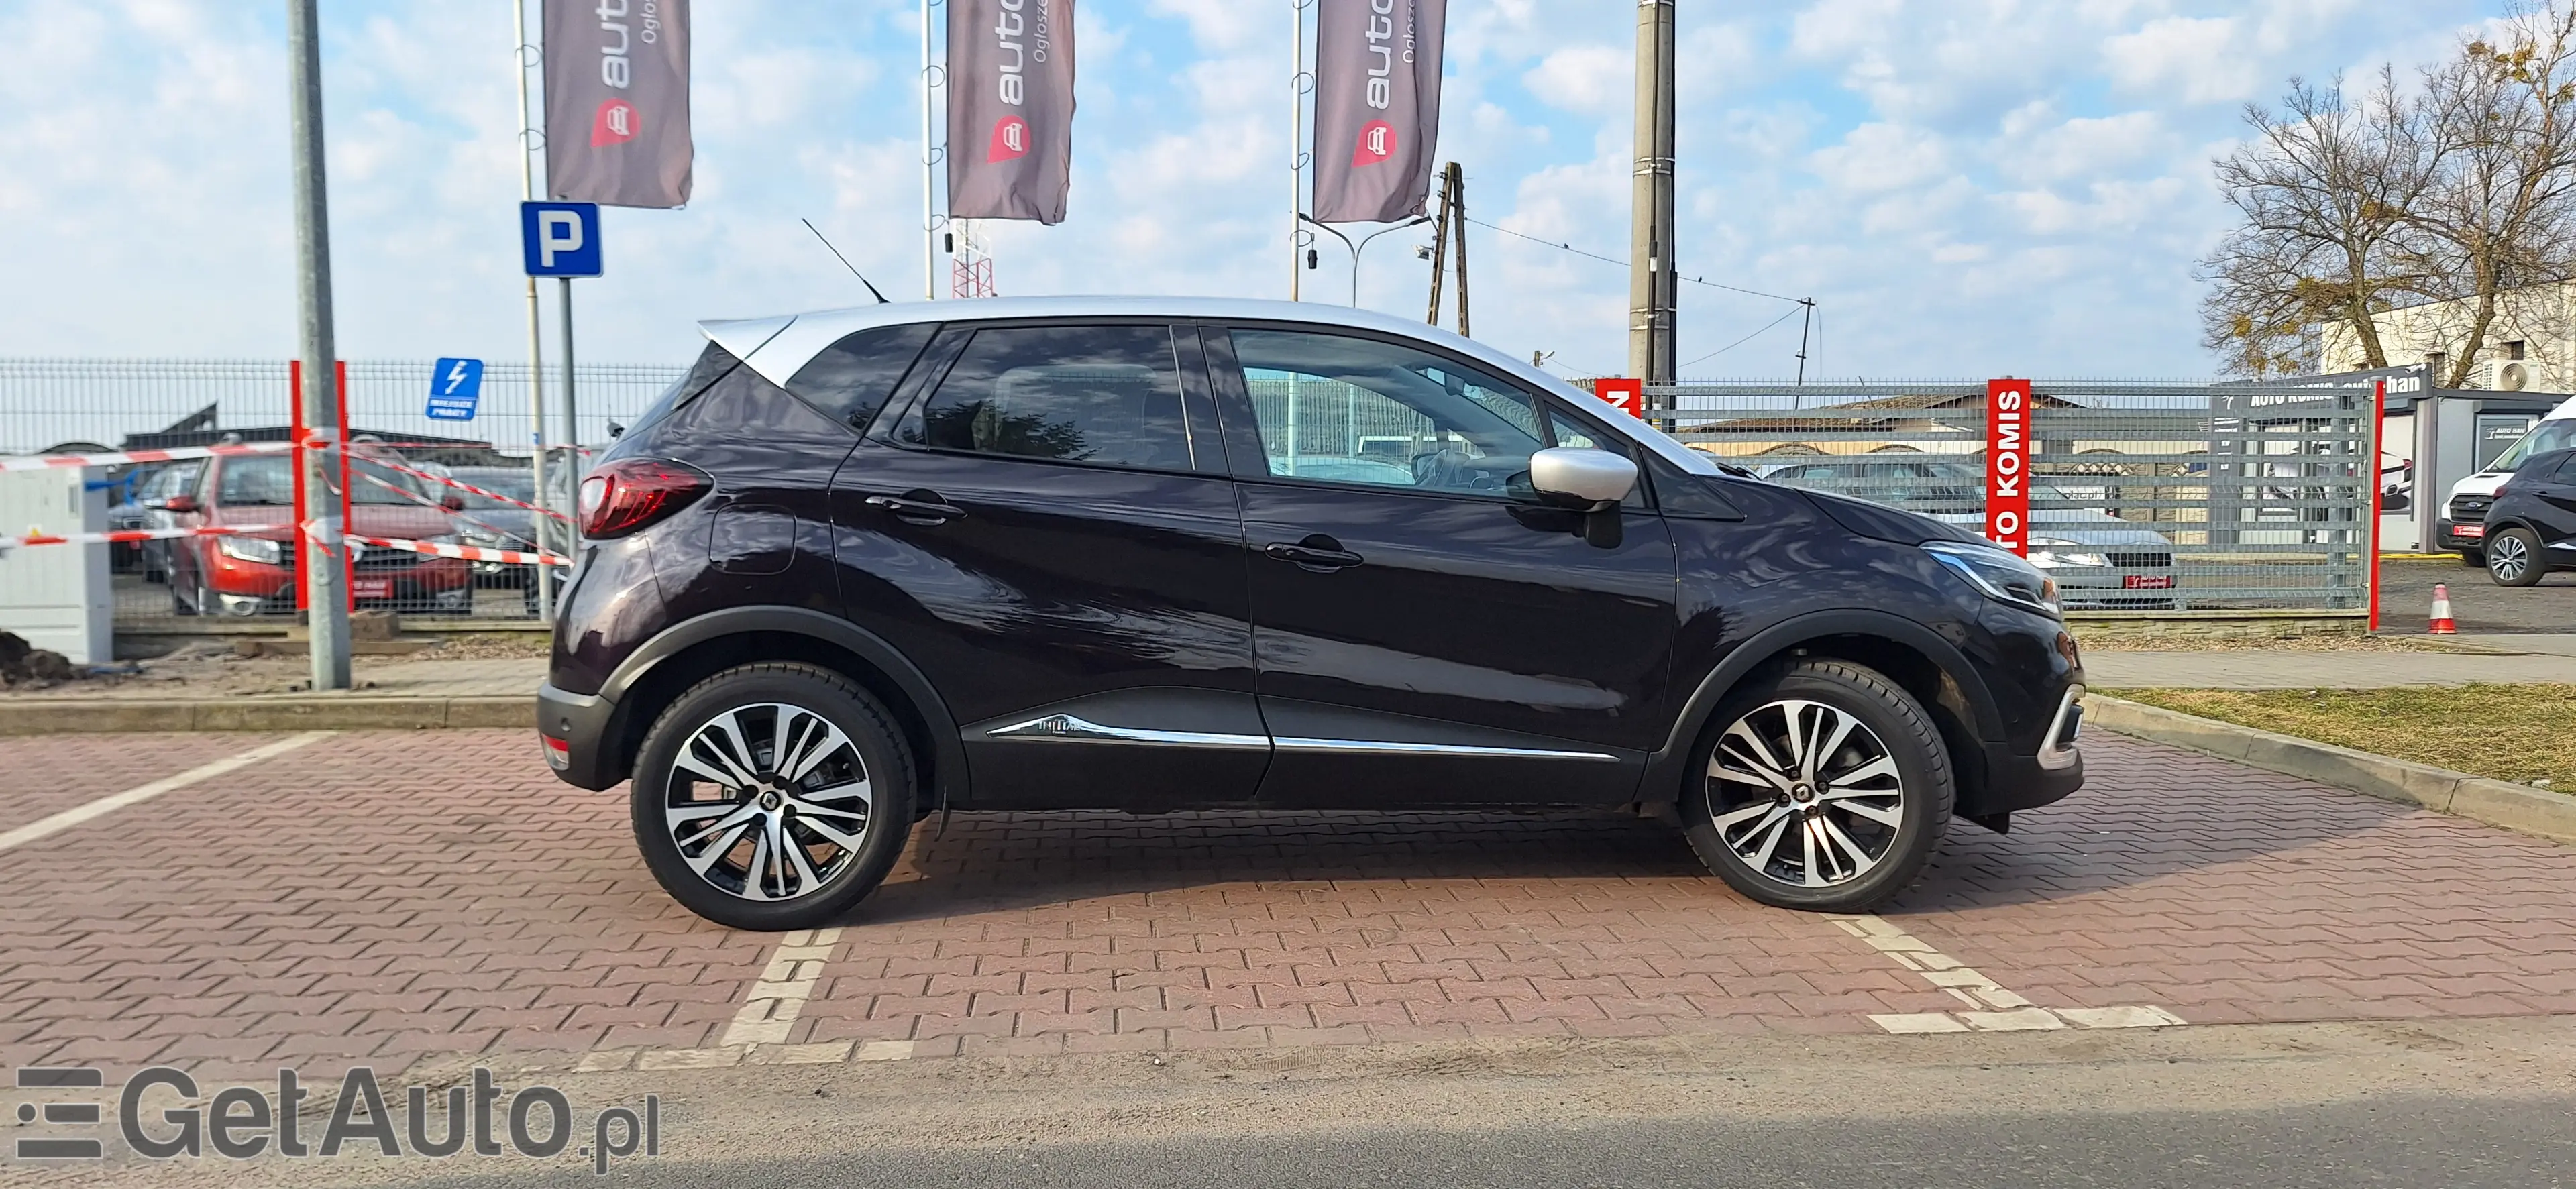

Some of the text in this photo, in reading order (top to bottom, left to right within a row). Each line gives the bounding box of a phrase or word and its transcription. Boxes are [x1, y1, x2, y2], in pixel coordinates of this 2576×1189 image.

[639, 0, 661, 44] Ogło
[539, 210, 584, 267] P
[1997, 390, 2021, 496] KOMIS
